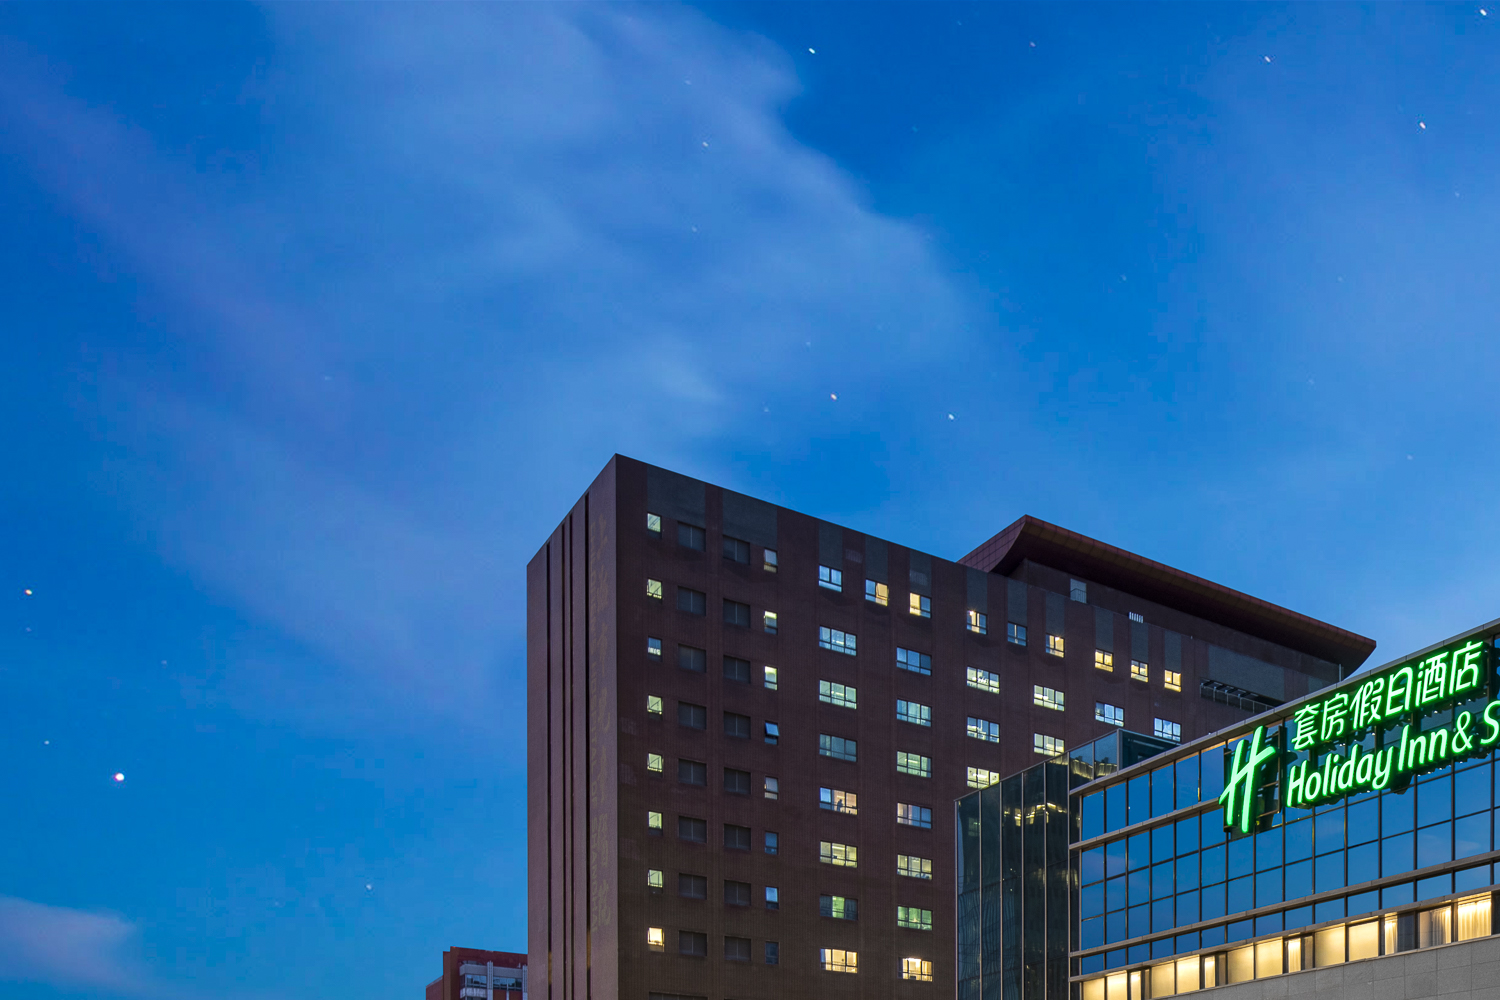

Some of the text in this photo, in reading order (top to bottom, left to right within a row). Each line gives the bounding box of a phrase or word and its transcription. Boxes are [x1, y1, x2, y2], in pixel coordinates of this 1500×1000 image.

[1290, 640, 1485, 751] 套房假日酒店
[1286, 744, 1397, 808] Holiday
[1397, 723, 1449, 771] Inn
